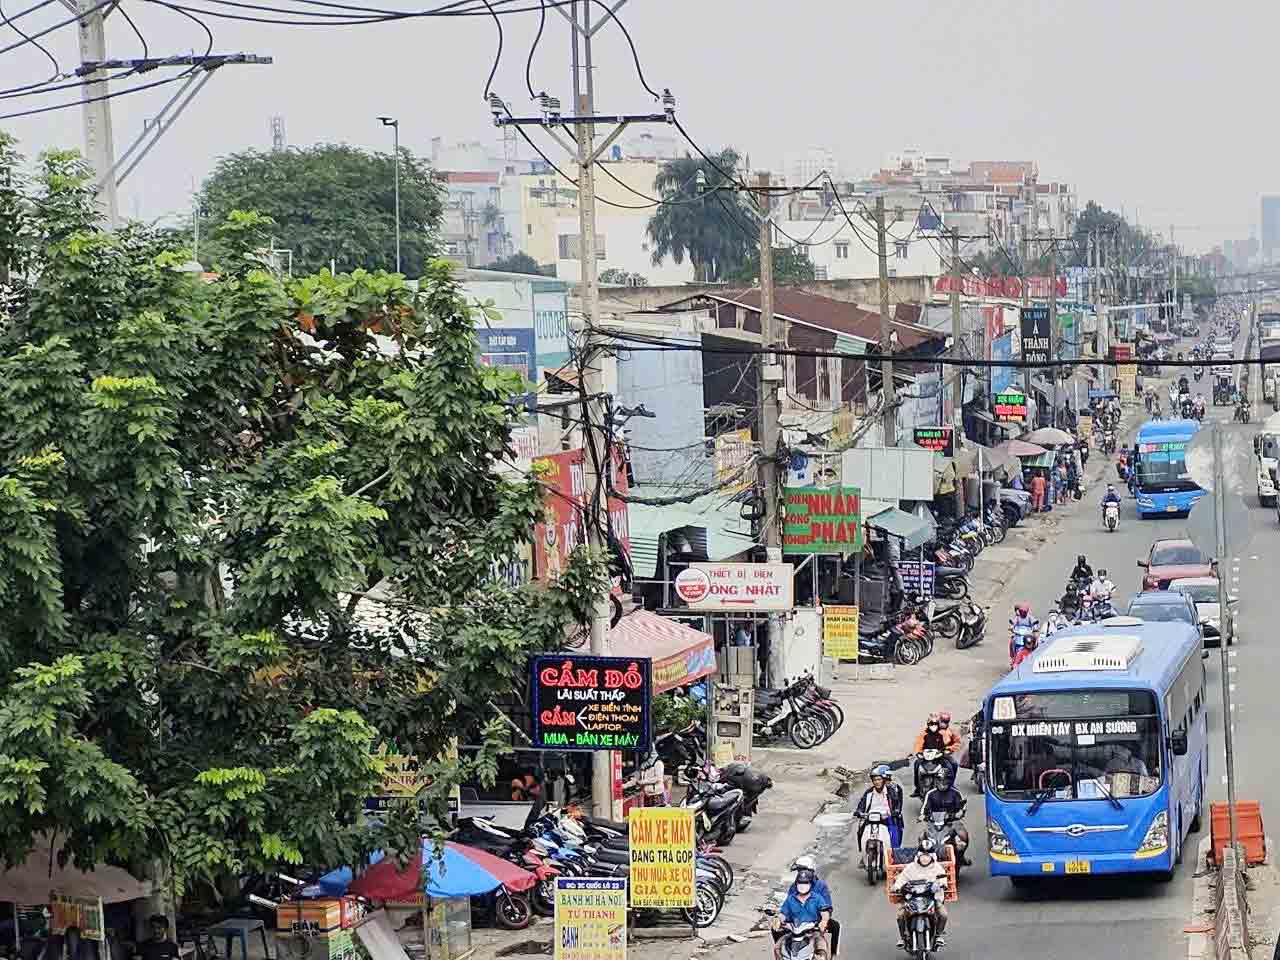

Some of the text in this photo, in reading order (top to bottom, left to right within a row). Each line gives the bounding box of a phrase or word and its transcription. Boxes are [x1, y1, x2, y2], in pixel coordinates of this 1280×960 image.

[540, 661, 642, 689] CẦM ĐỒ
[557, 687, 626, 701] LÃI SUẤT THẤP
[540, 705, 577, 726] CẦM
[1011, 725, 1028, 737] BX
[1052, 721, 1071, 735] TÂY
[1075, 724, 1090, 735] BX
[1090, 723, 1104, 734] AN
[543, 733, 569, 744] MUA
[576, 731, 598, 745] BÁN
[600, 734, 613, 745] XE
[614, 733, 639, 746] MÁY
[656, 819, 669, 844] XE
[657, 844, 674, 863] TRẢ
[632, 867, 649, 882] THU
[650, 867, 669, 882] MUA
[662, 884, 692, 896] CAO
